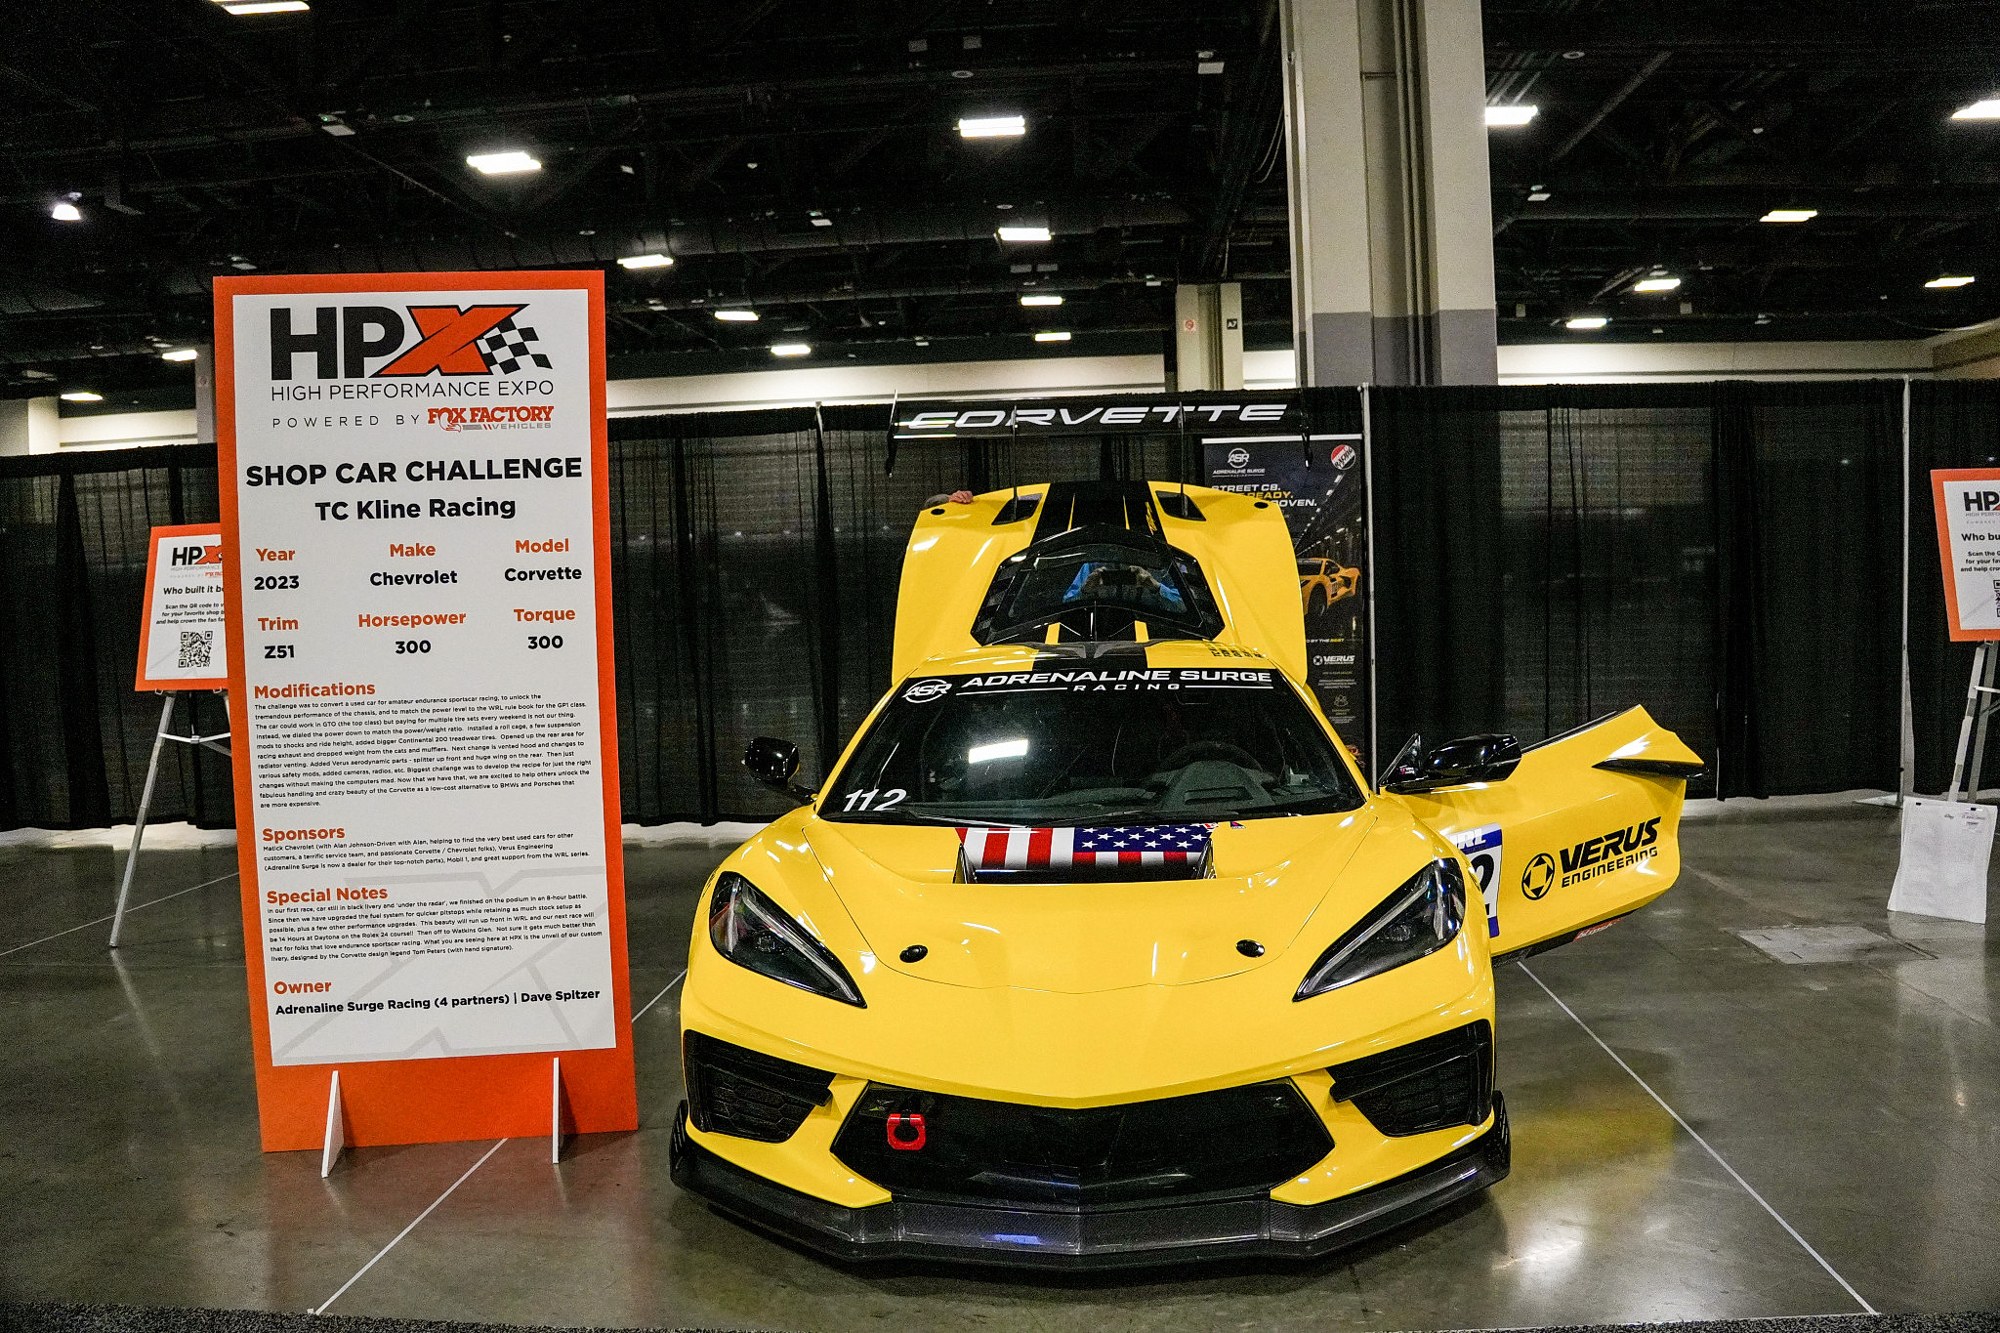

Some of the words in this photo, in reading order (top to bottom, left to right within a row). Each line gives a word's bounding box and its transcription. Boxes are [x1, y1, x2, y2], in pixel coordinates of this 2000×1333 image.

[270, 304, 530, 380] HPX
[271, 385, 322, 402] HIGH
[330, 382, 490, 400] PERFORMANCE
[498, 380, 554, 396] EXPO
[272, 415, 380, 429] POWERED
[396, 414, 420, 425] BY
[428, 407, 467, 426] FOX
[470, 406, 554, 423] FACTORY
[908, 404, 1287, 429] CORVETTE
[492, 422, 552, 430] VEHICLES
[1227, 453, 1250, 463] ASR
[245, 464, 327, 487] SHOP
[335, 462, 397, 484] CAR
[405, 457, 583, 483] CHALLENGE
[315, 502, 349, 521] TC
[357, 499, 421, 520] Kline
[429, 497, 516, 522] Racing
[1963, 491, 2000, 512] HP
[515, 538, 570, 553] Model
[1961, 533, 1986, 541] Who
[256, 547, 296, 562] Year
[389, 542, 436, 558] Make
[254, 575, 300, 590] 2023
[369, 569, 458, 587] Chevrolet
[504, 567, 582, 582] Corvette
[163, 586, 183, 595] Who
[185, 585, 205, 594] built
[206, 585, 214, 593] it
[258, 616, 299, 632] Trim
[358, 611, 467, 631] Horsepower
[513, 607, 576, 625] Torque
[395, 640, 432, 654] 300
[527, 635, 564, 650] 300
[264, 645, 295, 659] Z51
[961, 670, 1171, 688] ADRENALINE
[1179, 670, 1273, 683] SURGE
[1074, 683, 1180, 692] RACING
[254, 682, 375, 699] Modifications
[903, 682, 951, 699] ASR
[267, 702, 297, 712] challenge
[320, 700, 344, 708] convert
[350, 699, 365, 707] used
[377, 698, 387, 706] for
[388, 697, 413, 705] amateur
[415, 696, 447, 704] endurance
[448, 695, 477, 704] sportscar
[509, 693, 529, 701] unlock
[259, 791, 286, 799] fabulous
[287, 790, 314, 799] handling
[346, 787, 368, 797] beauty
[388, 785, 415, 793] Corvette
[430, 784, 456, 792] low-cost
[458, 782, 491, 790] alternative
[500, 781, 519, 789] BMWs
[843, 789, 907, 812] 112
[262, 827, 346, 844] Sponsors
[284, 843, 314, 851] Chevrolet
[315, 842, 332, 851] (with
[429, 837, 453, 846] helping
[475, 835, 486, 843] the
[487, 836, 500, 844] very
[516, 833, 531, 841] used
[546, 832, 556, 840] for
[1559, 816, 1661, 874] VERUS
[1561, 846, 1658, 888] ENGINEERING
[267, 888, 331, 906] Special
[336, 887, 388, 901] Notes
[290, 953, 318, 963] designed
[340, 950, 367, 959] Corvette
[368, 949, 389, 959] design
[389, 948, 411, 958] legend
[412, 947, 426, 955] Tom
[426, 946, 446, 954] Peters
[447, 946, 464, 955] (with
[273, 981, 332, 995] Owner
[275, 1002, 344, 1015] Adrenaline
[347, 1000, 384, 1015] Surge
[388, 997, 431, 1012] Racing
[434, 997, 448, 1010] (4
[451, 993, 510, 1008] partners)
[521, 991, 552, 1003] Dave
[555, 989, 600, 1003] Spitzer
